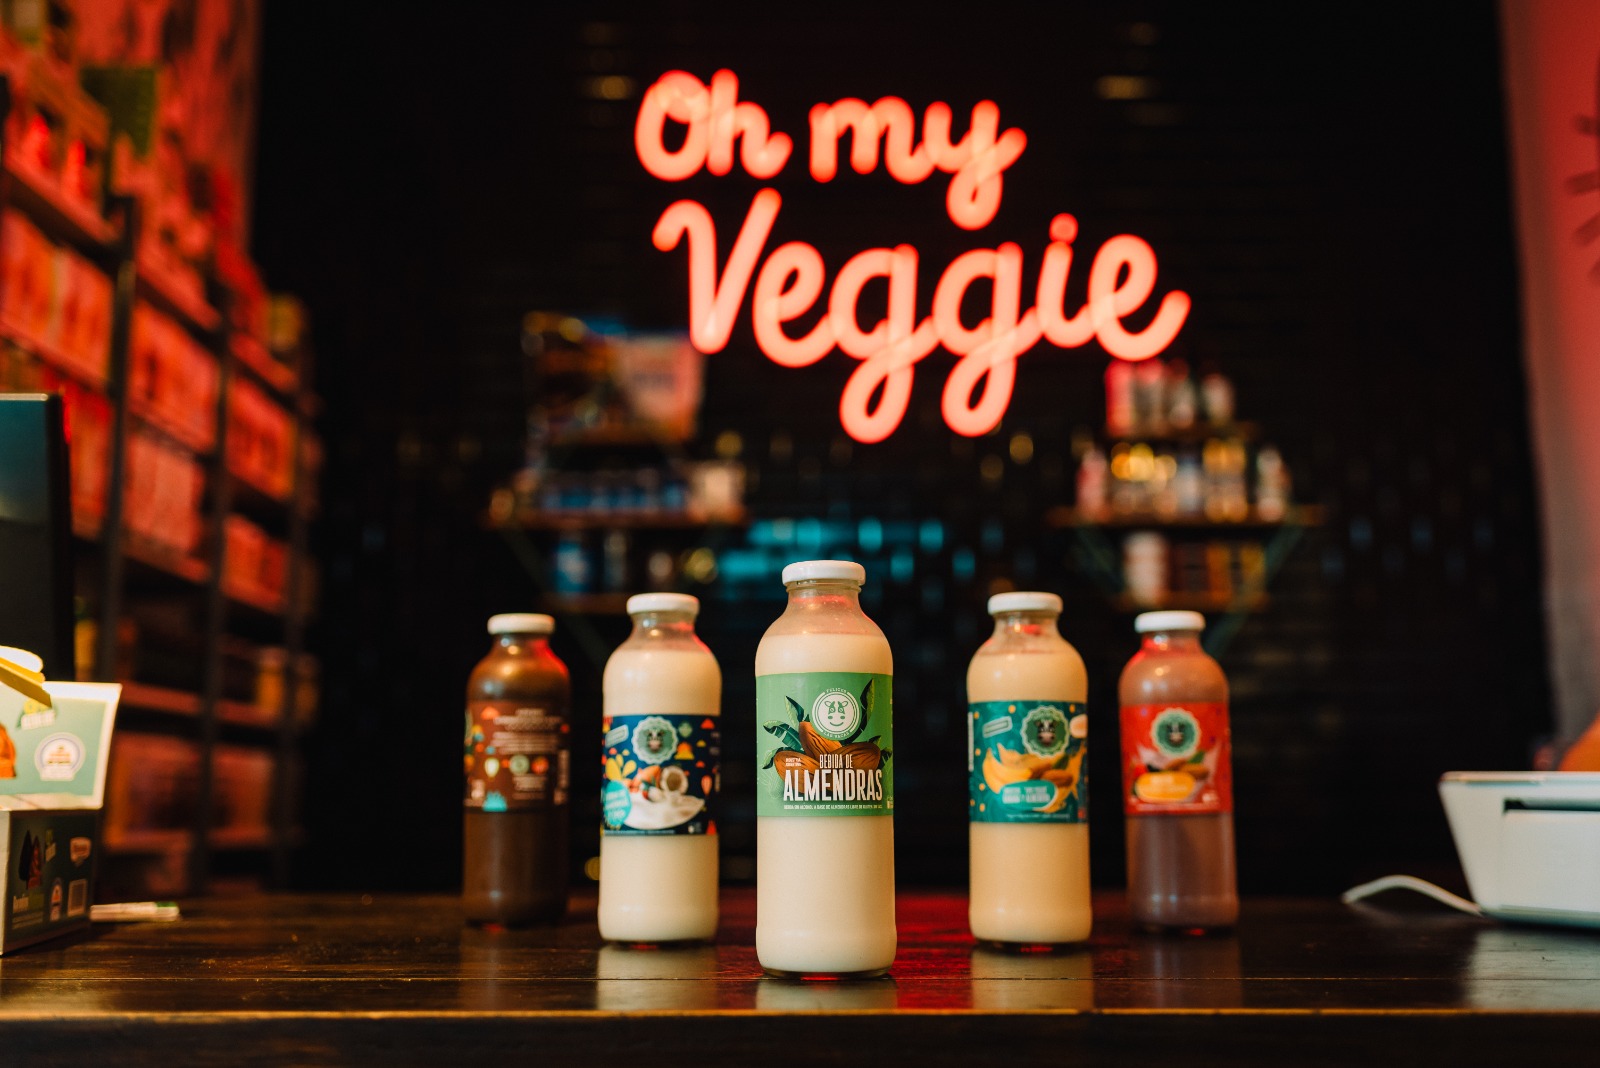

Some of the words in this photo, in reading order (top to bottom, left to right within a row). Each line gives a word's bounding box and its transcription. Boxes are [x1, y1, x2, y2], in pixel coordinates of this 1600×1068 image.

[635, 69, 793, 181] Oh
[809, 95, 1027, 230] my
[652, 187, 1191, 443] Veggie
[783, 769, 883, 801] ALMENDRAS
[819, 754, 843, 769] BEBIDA
[845, 754, 853, 769] DE
